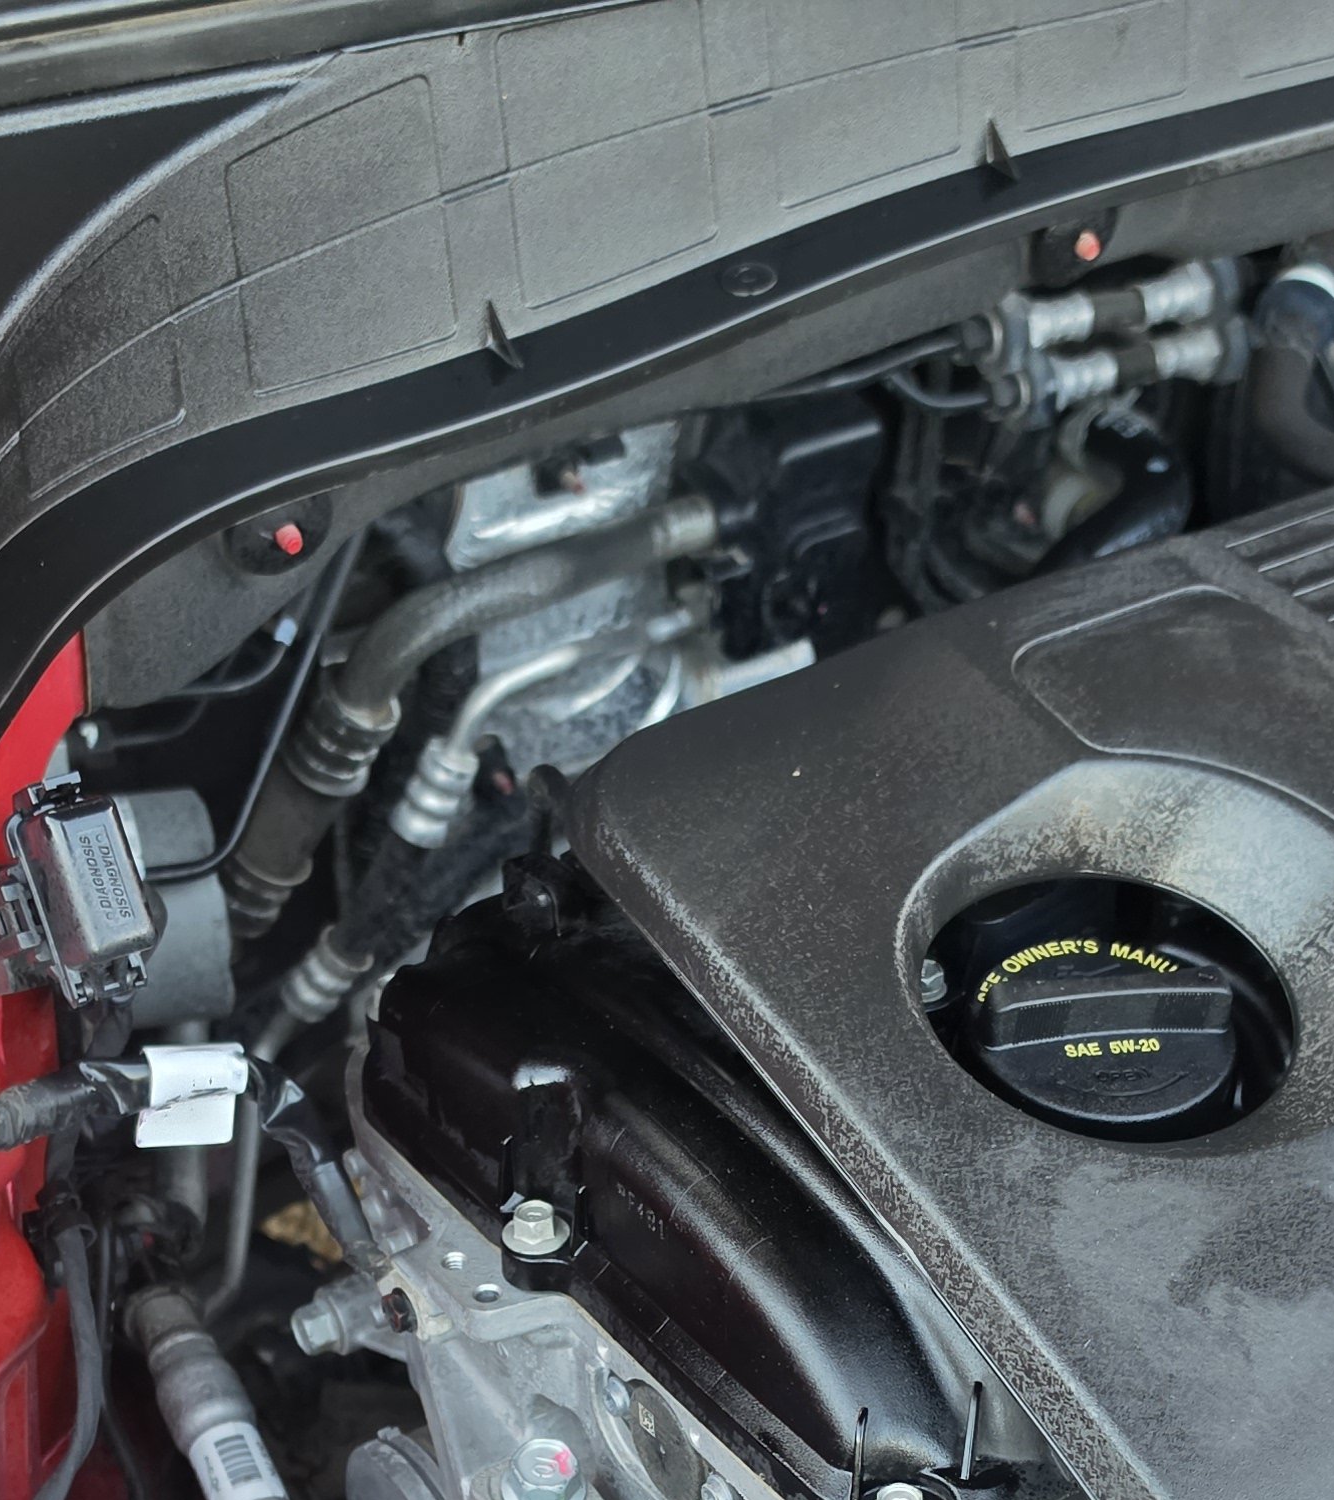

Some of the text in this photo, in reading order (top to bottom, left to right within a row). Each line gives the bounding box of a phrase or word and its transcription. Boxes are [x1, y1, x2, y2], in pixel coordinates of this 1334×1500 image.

[78, 834, 113, 910] DIAGNOSIS
[98, 845, 132, 919] DIAGNOSIS
[1001, 938, 1099, 974] OWNER'S
[1064, 1037, 1161, 1058] SAE 5W-20
